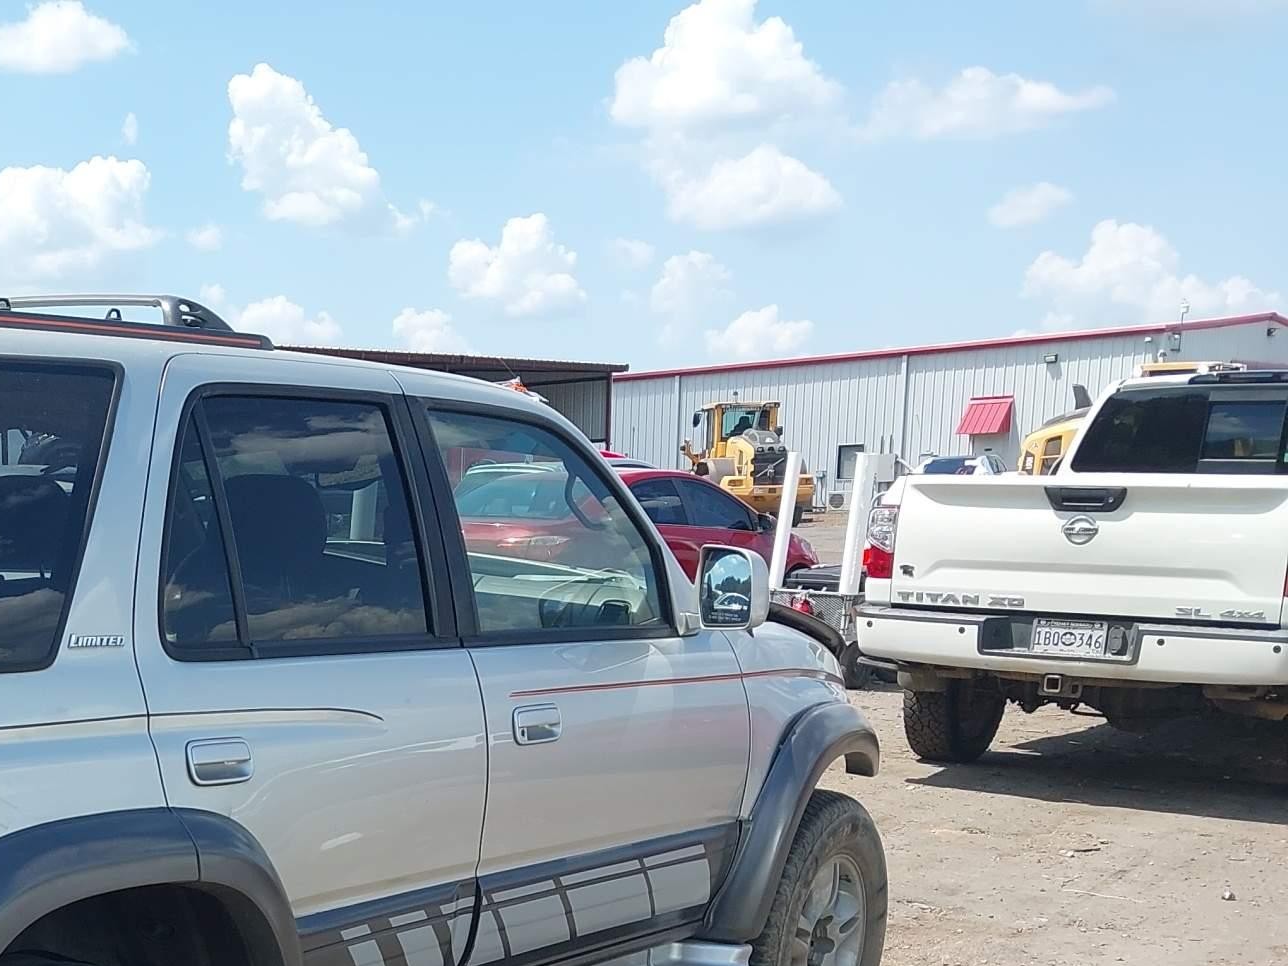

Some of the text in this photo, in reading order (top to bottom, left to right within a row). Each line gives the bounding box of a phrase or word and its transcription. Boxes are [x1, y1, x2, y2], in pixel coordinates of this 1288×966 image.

[896, 591, 1025, 608] TITAN XD
[1175, 606, 1212, 618] SL
